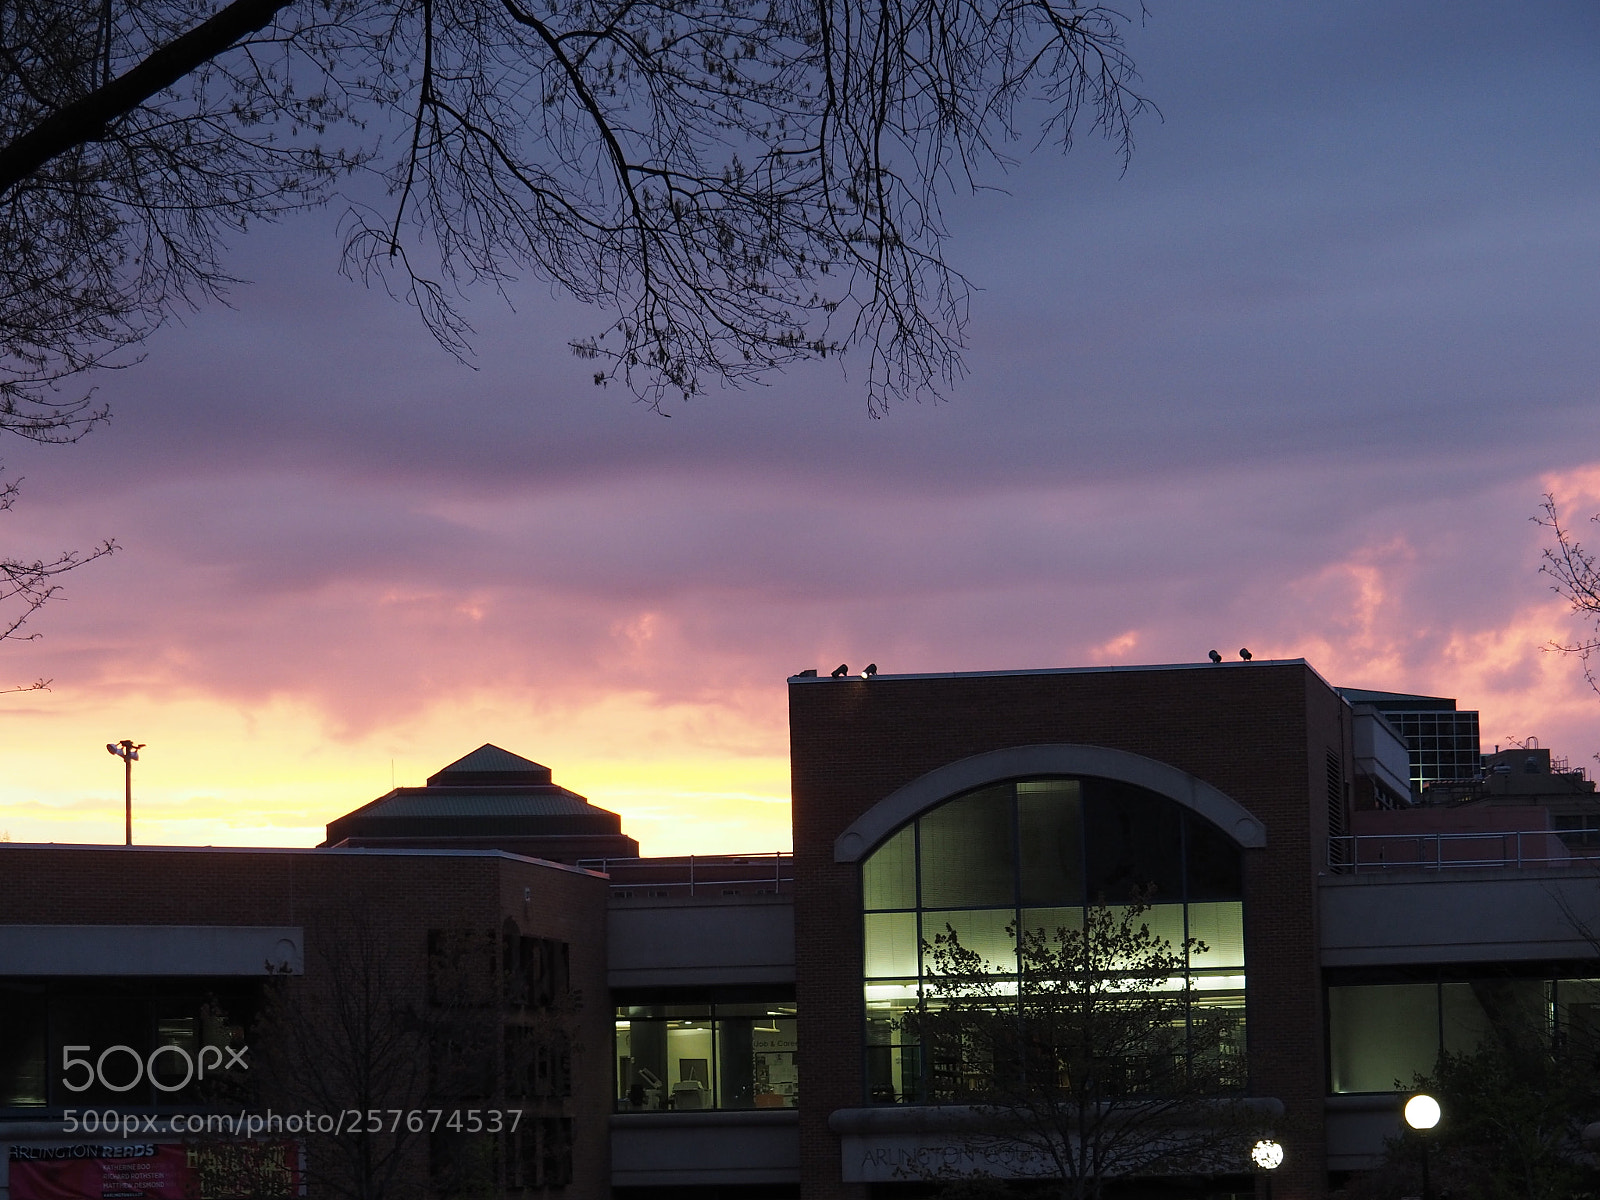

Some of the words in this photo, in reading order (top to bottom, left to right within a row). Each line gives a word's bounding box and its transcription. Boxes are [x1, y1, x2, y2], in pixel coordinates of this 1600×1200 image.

[9, 1145, 98, 1159] ARLINGTON
[101, 1144, 155, 1157] READS
[861, 1146, 975, 1167] ARLINGTON
